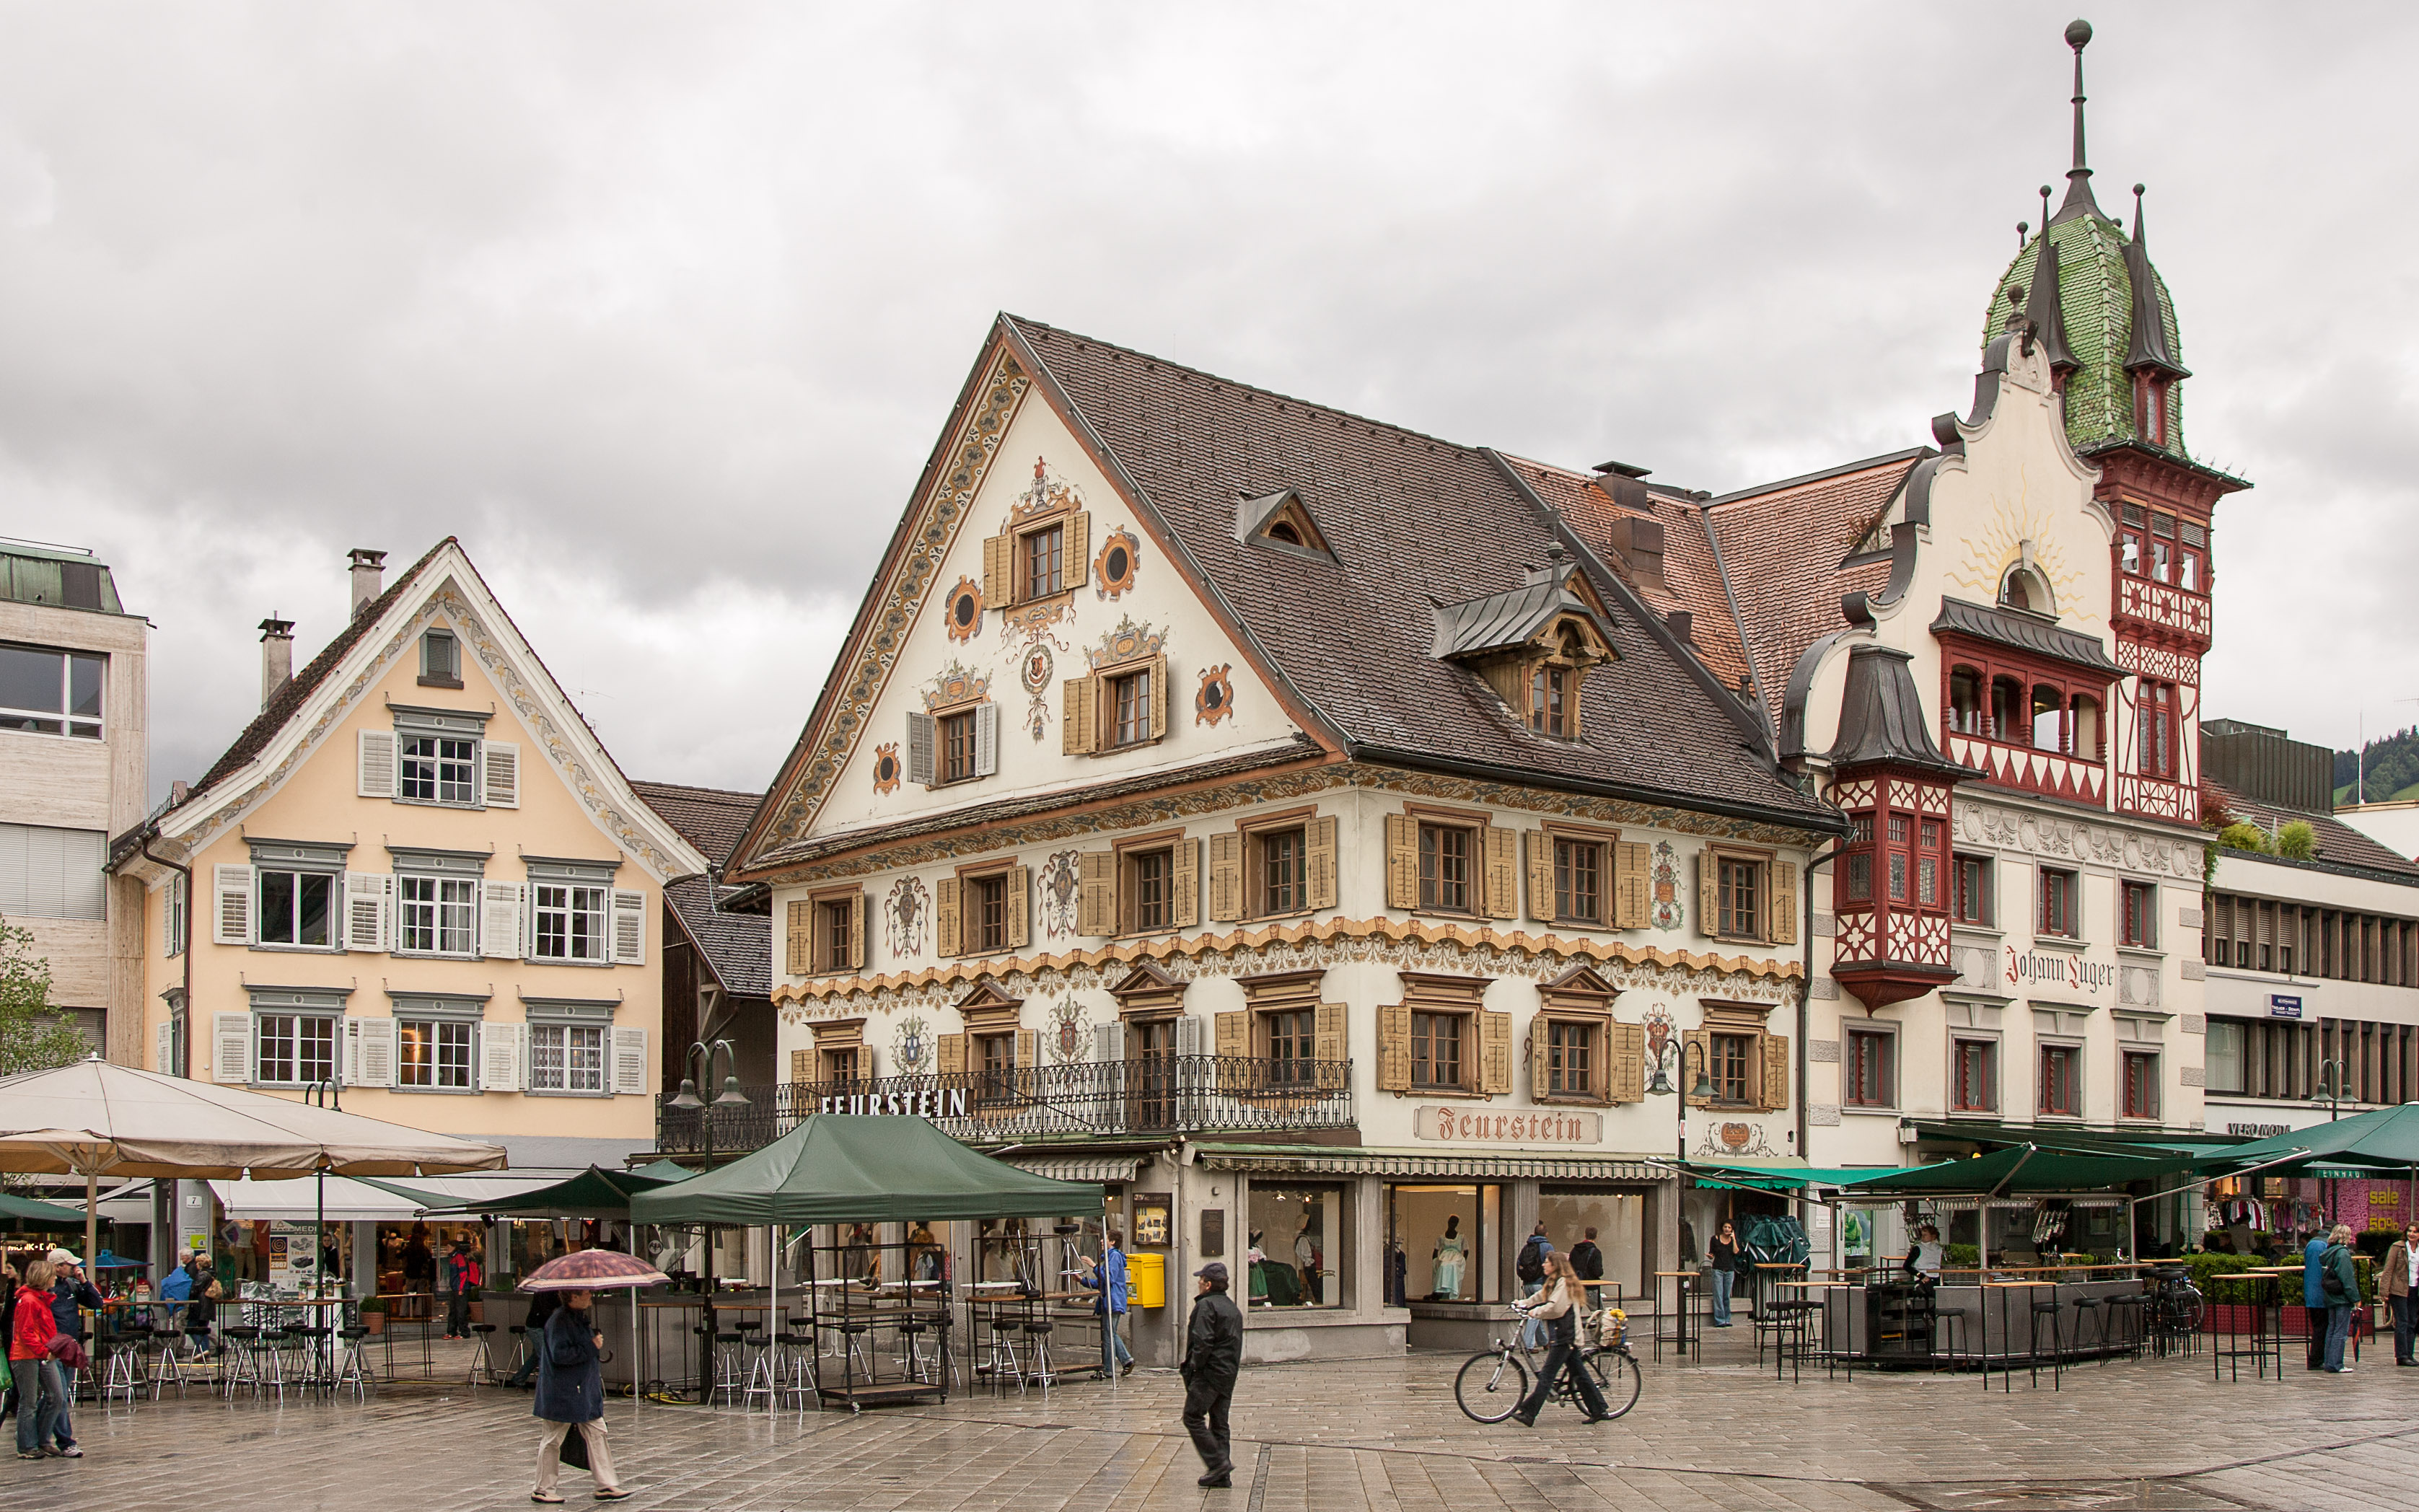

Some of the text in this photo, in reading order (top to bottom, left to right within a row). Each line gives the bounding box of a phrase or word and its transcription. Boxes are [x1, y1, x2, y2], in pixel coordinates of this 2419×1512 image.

[2006, 945, 2114, 993] Johann Luger
[821, 1088, 967, 1117] FEURSTEIN
[1437, 1107, 1582, 1141] Feurstein
[2227, 1122, 2258, 1135] VERO
[2369, 1187, 2399, 1204] sale
[2369, 1217, 2399, 1231] 50%
